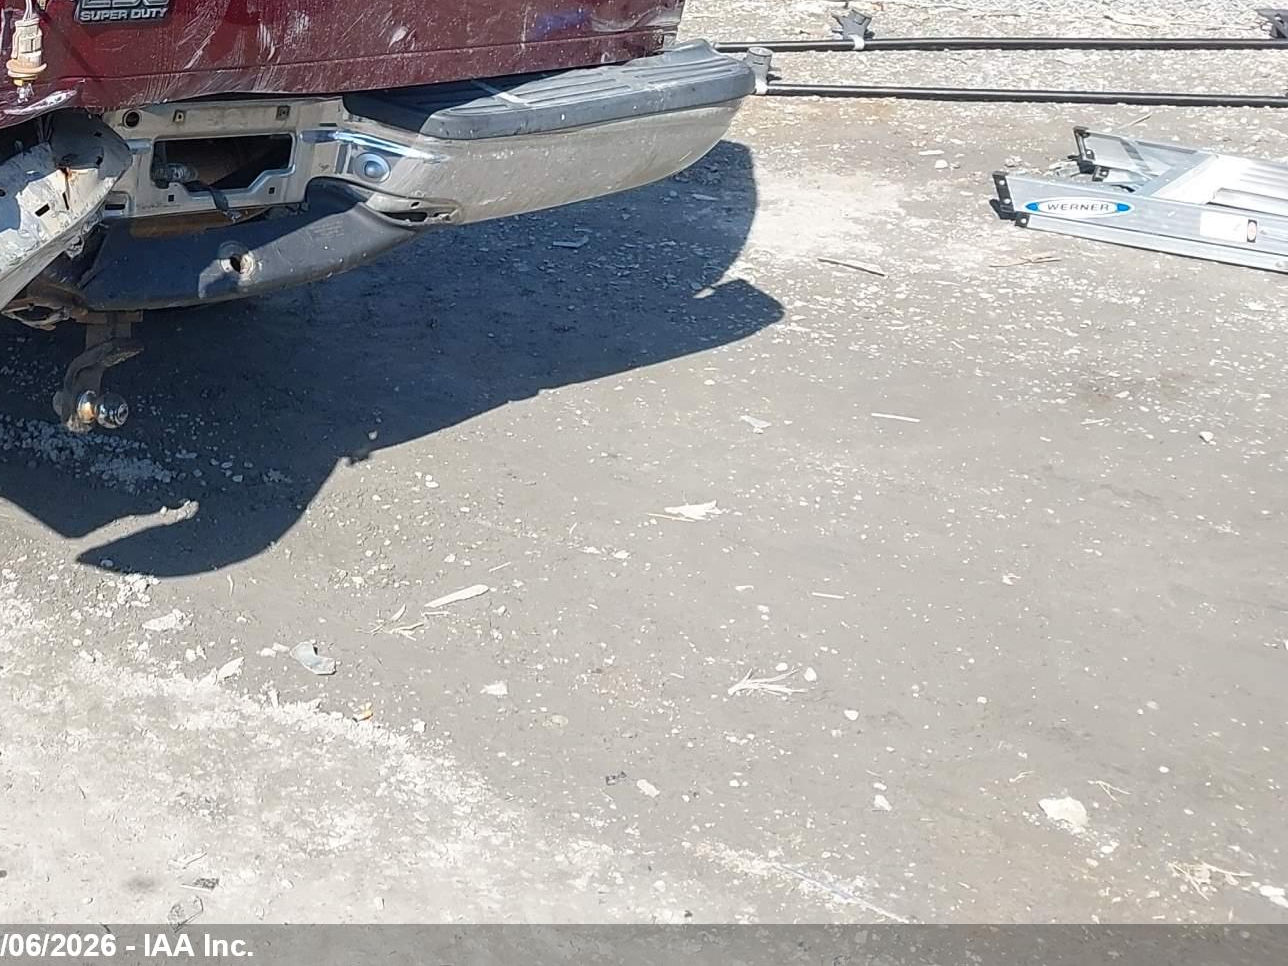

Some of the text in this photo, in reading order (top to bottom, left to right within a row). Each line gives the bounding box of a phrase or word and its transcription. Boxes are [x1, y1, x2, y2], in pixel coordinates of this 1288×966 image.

[80, 7, 169, 21] SUPER DUTY
[1047, 202, 1109, 212] WERNER
